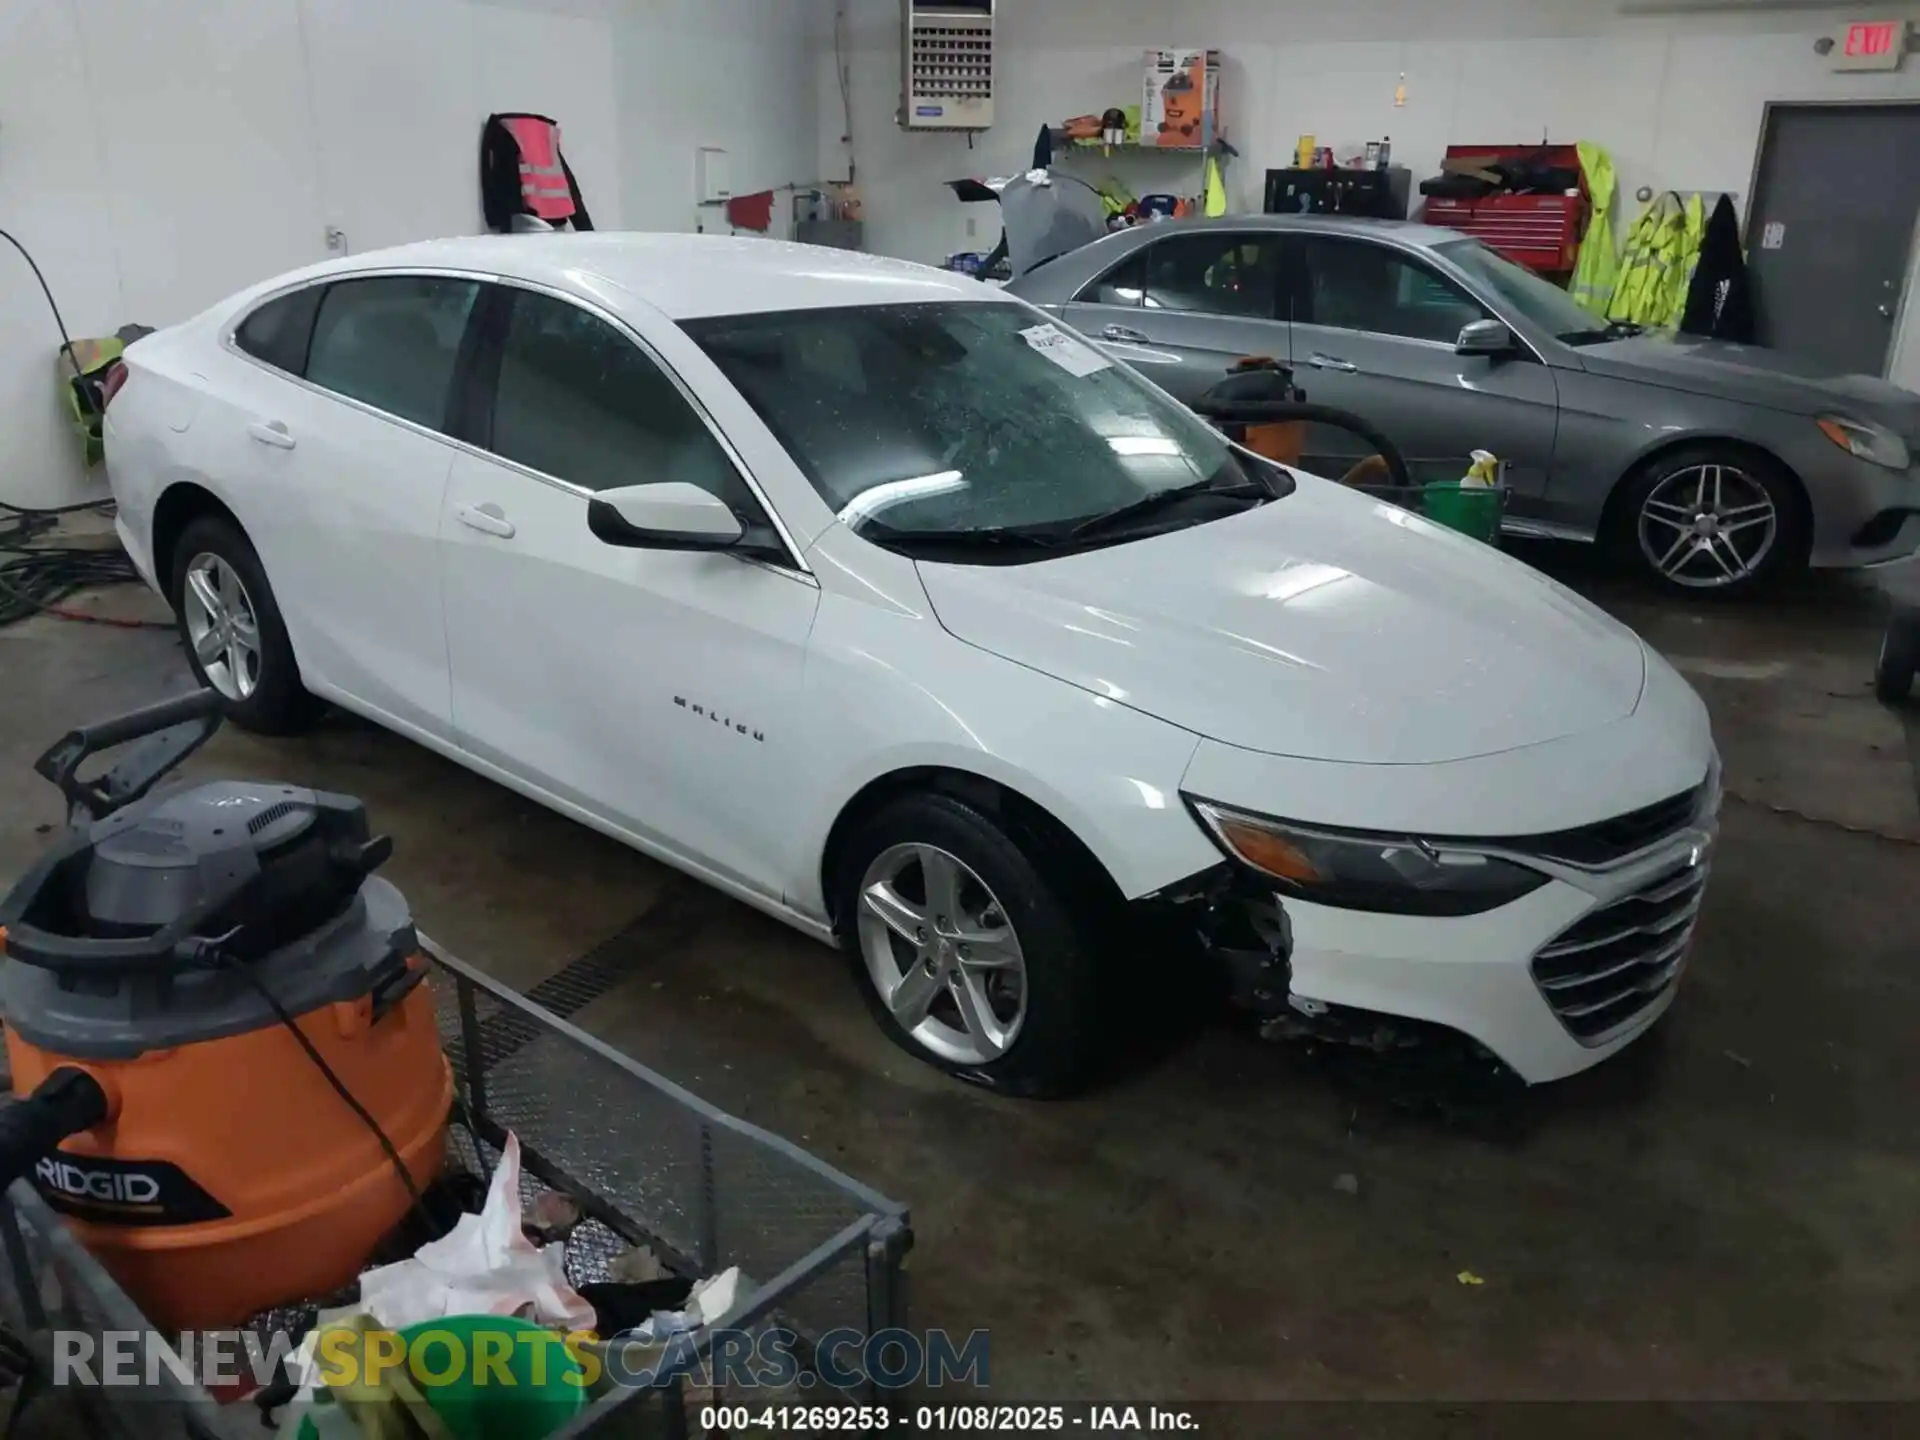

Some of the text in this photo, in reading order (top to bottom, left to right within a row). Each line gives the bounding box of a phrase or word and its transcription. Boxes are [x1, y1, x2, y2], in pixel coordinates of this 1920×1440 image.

[1844, 23, 1895, 57] EXIT
[673, 695, 765, 743] MALIBU
[35, 1156, 160, 1202] RIDGID
